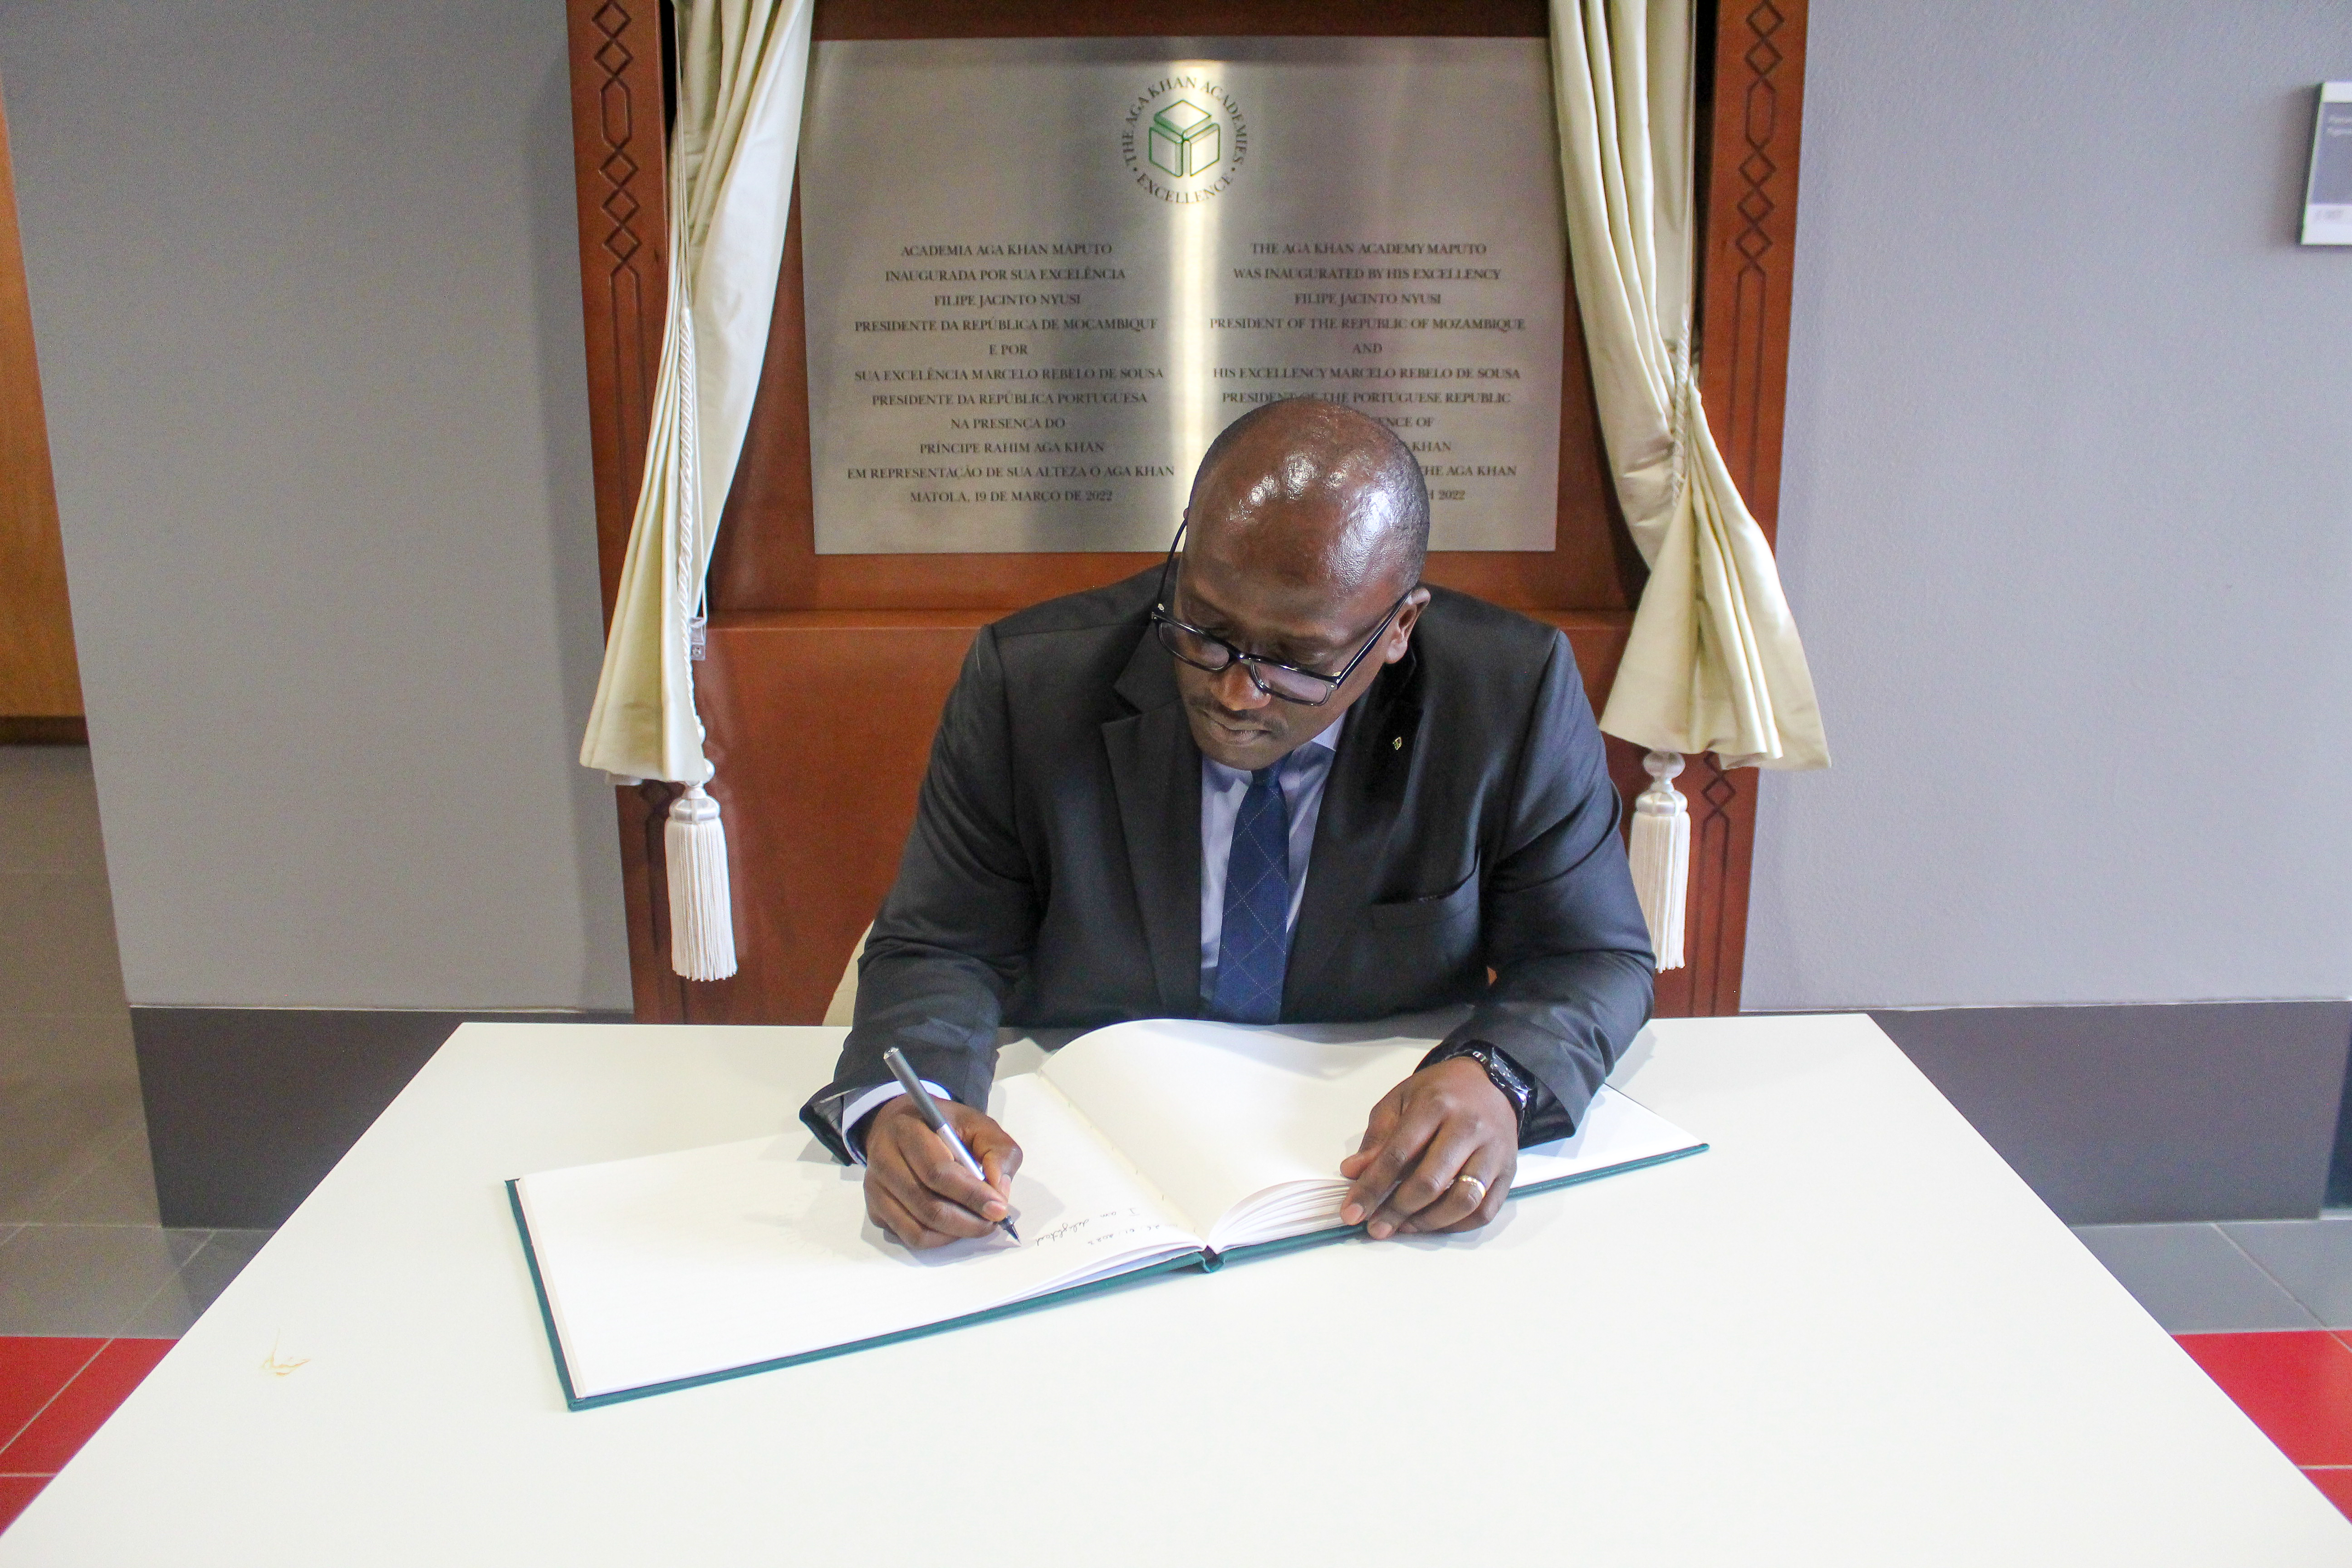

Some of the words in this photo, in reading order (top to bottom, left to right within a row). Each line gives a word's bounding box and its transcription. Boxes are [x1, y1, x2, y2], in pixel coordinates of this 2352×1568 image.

[1147, 76, 1197, 98] KHAN
[1126, 95, 1150, 127] AGA
[1200, 81, 1248, 166] ACADEMIES
[1122, 132, 1137, 166] THE
[1137, 172, 1233, 204] EXCELLENCE
[901, 245, 973, 255] ACADEMIA
[976, 245, 1004, 255] AGA
[1008, 244, 1048, 255] KHAN
[1053, 244, 1112, 254] MAPUTO
[1252, 243, 1278, 254] THE
[1283, 243, 1310, 254] AGA
[1315, 243, 1354, 254] KHAN
[1358, 243, 1424, 254] ACADEMY
[1427, 243, 1486, 254] MAPUTO
[886, 270, 976, 281] INAUGURADA
[980, 270, 1007, 280] POR
[1011, 270, 1036, 280] SUA
[1234, 269, 1261, 279] WAS
[1265, 269, 1364, 279] INAUGURATED
[1368, 269, 1384, 279] BY
[1387, 269, 1410, 279] HIS
[1413, 269, 1501, 279] EXCELLENCY
[935, 295, 976, 305] FILIPE
[980, 294, 1037, 307] JACINTO
[1041, 294, 1080, 305] NYUSI
[1295, 293, 1337, 304] FILIPE
[1340, 293, 1397, 306] JACINTO
[1402, 293, 1441, 304] NYUSI
[855, 320, 936, 331] PRESIDENTE
[941, 320, 959, 330] DA
[1042, 319, 1059, 330] DE
[1210, 318, 1284, 328] PRESIDENT
[1288, 318, 1306, 328] OF
[1310, 318, 1338, 328] THE
[1342, 318, 1406, 328] REPUBLIC
[1411, 318, 1428, 328] OF
[1433, 318, 1525, 331] MOZAMBIQUE
[989, 344, 998, 355] E
[1001, 344, 1028, 354] POR
[1352, 343, 1382, 354] AND
[855, 370, 880, 380] SUA
[972, 369, 1038, 379] MARCELO
[1043, 368, 1095, 379] REBELO
[1099, 368, 1117, 379] DE
[1120, 368, 1163, 378] SOUSA
[1214, 368, 1235, 378] HIS
[1239, 368, 1326, 378] EXCELLENCY
[1330, 368, 1396, 378] MARCELO
[1400, 368, 1452, 378] REBELO
[1456, 368, 1472, 378] DE
[1477, 368, 1520, 378] SOUSA
[872, 394, 953, 405] PRESIDENTE
[957, 394, 975, 404] DA
[1058, 393, 1147, 403] PORTUGUESA
[1353, 392, 1441, 403] PORTUGUESE
[1446, 392, 1510, 403] REPUBLIC
[951, 418, 969, 429] NA
[1045, 418, 1065, 428] DO
[1416, 417, 1434, 427] OF
[985, 443, 1029, 453] RAHIM
[1034, 442, 1060, 453] AGA
[1065, 442, 1104, 452] KHAN
[1412, 441, 1451, 452] KHAN
[848, 468, 867, 479] EM
[986, 467, 1002, 478] DE
[1007, 467, 1032, 477] SUA
[1038, 467, 1087, 477] ALTEZA
[1090, 466, 1101, 477] O
[1106, 466, 1132, 477] AGA
[1135, 466, 1174, 476] KHAN
[1446, 466, 1473, 476] AGA
[1477, 466, 1517, 476] KHAN
[911, 492, 970, 503] MATOLA,
[975, 491, 986, 502] 19
[991, 491, 1007, 502] DE
[1065, 491, 1081, 501] DE
[1086, 490, 1112, 501] 2022
[1438, 490, 1466, 500] 2022
